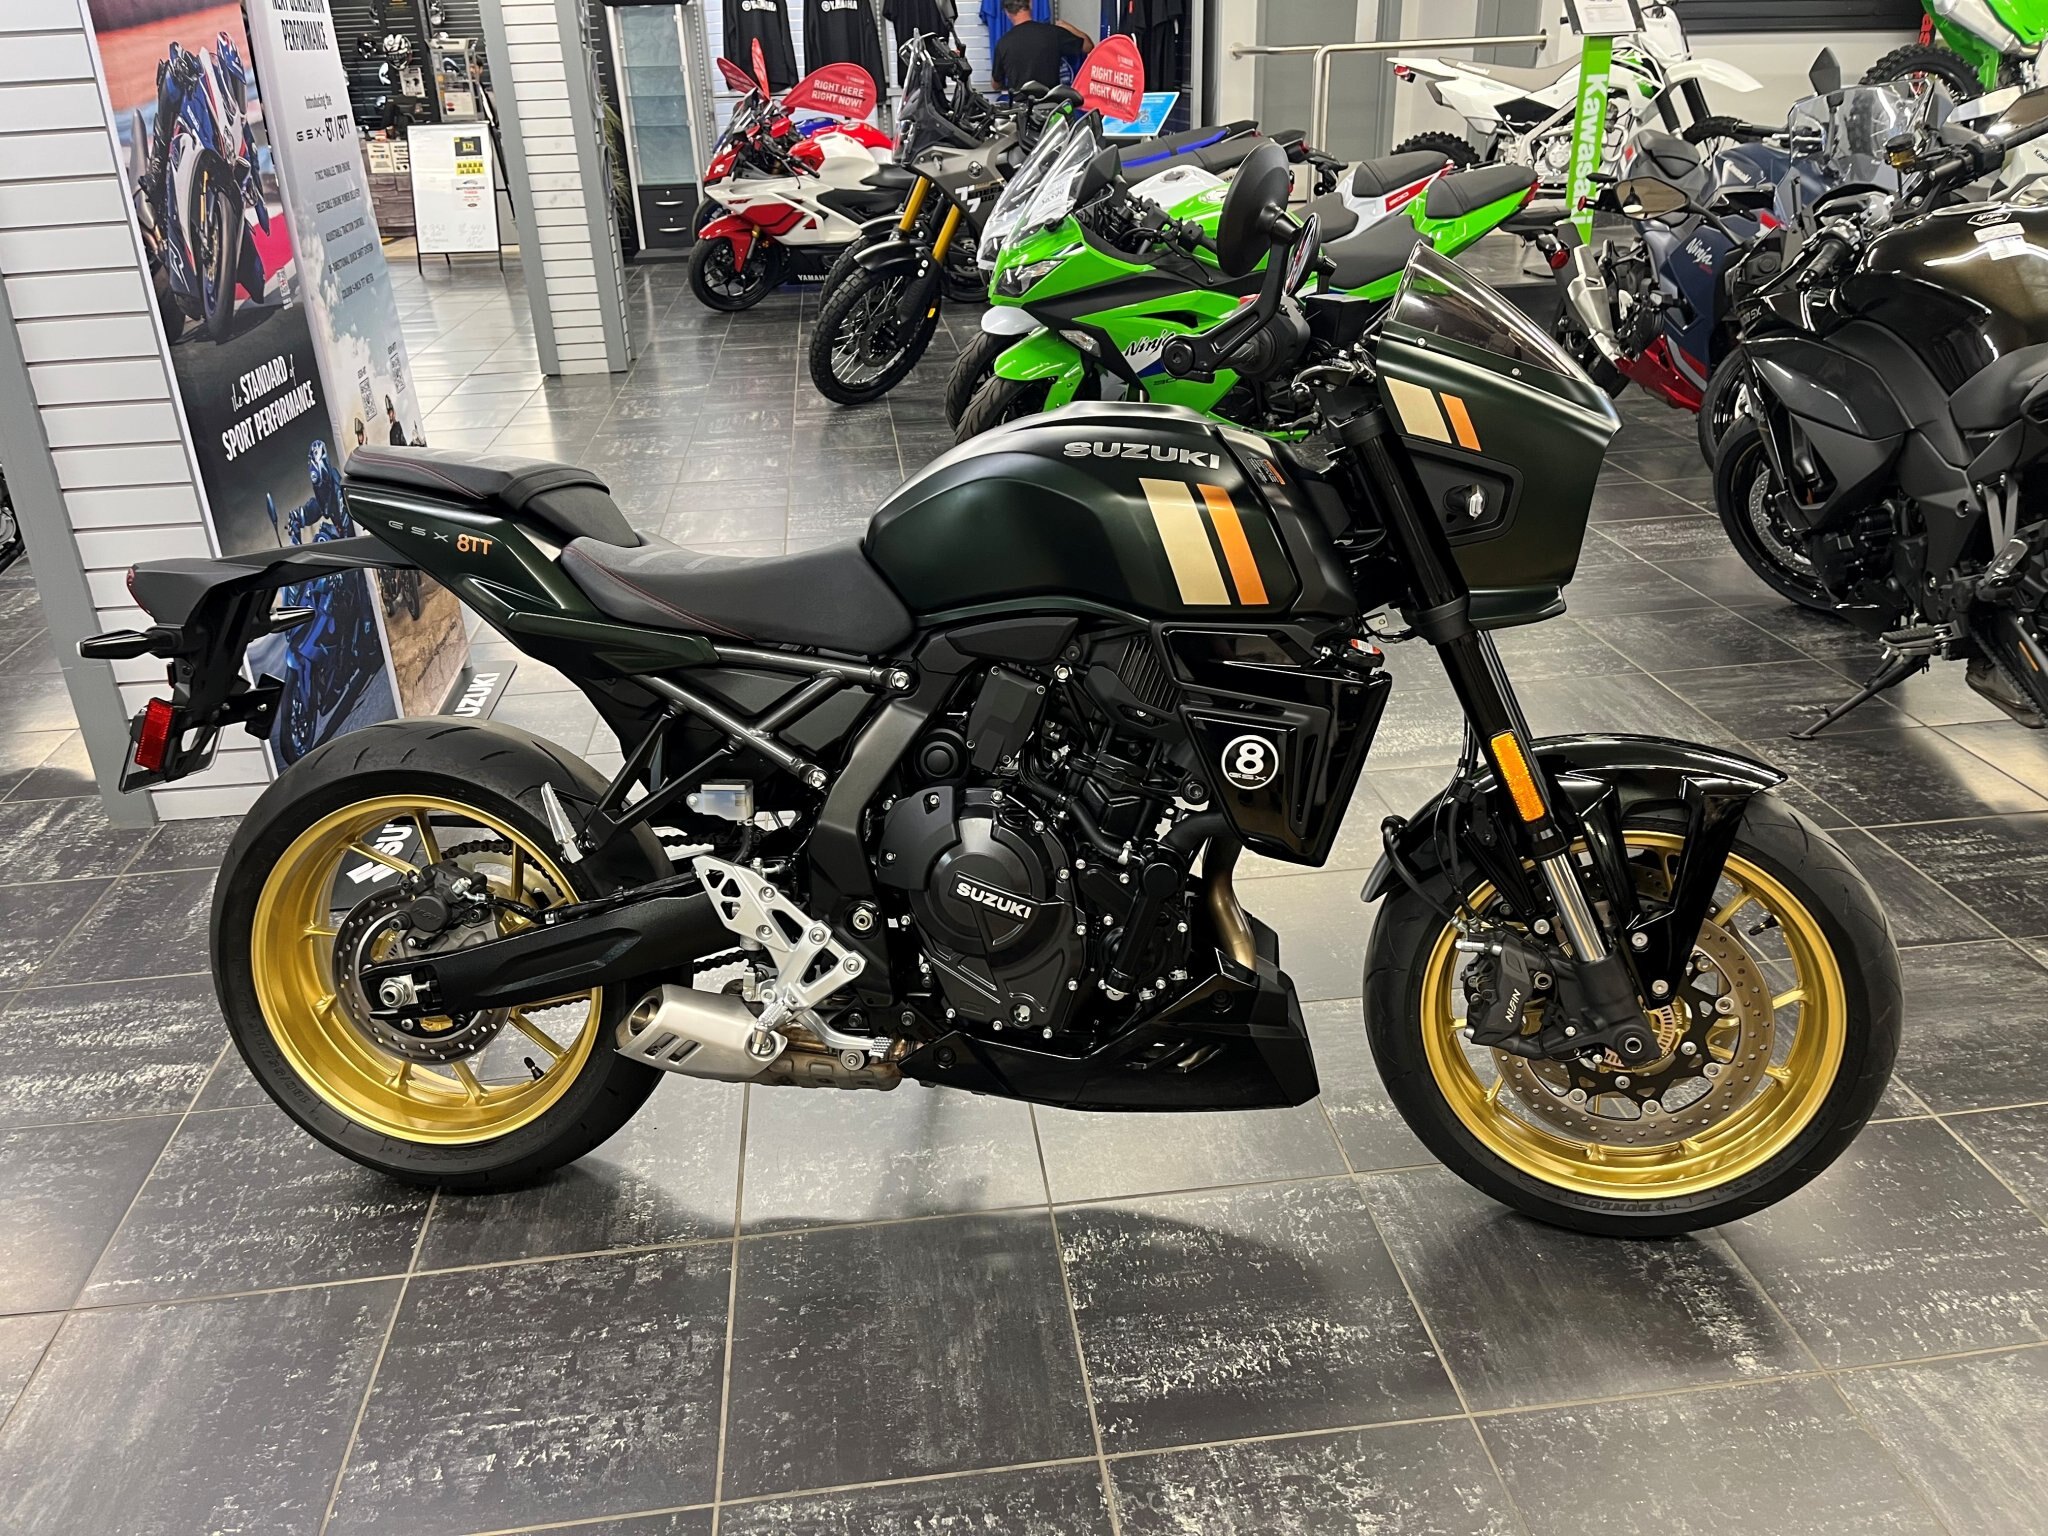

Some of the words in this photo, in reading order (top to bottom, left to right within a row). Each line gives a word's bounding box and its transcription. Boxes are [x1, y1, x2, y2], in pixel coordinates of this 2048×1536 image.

[829, 0, 858, 10] YAMAHA
[280, 19, 328, 50] PERFORMANCE
[814, 79, 840, 93] RIGHT
[841, 86, 864, 98] HERE
[1091, 66, 1113, 80] RIGHT
[1114, 72, 1134, 87] HERE
[812, 91, 837, 104] RIGHT
[837, 97, 863, 108] NOW!
[1089, 83, 1111, 98] RIGHT
[1111, 89, 1133, 105] NOW!
[1571, 74, 1609, 225] Kawasaki
[1685, 237, 1713, 264] Ninja
[231, 384, 244, 412] the
[239, 355, 288, 405] STANDARD
[290, 354, 297, 386] of
[222, 417, 257, 461] SPORT
[254, 380, 316, 441] PERFORMANCE
[1063, 441, 1220, 470] SUZUKI
[456, 533, 493, 555] 8TT
[453, 672, 501, 717] UZUKI
[1235, 742, 1265, 775] 8
[1228, 771, 1268, 782] GSX
[956, 882, 1032, 919] SUZUKI
[1504, 988, 1521, 1023] NISSIN
